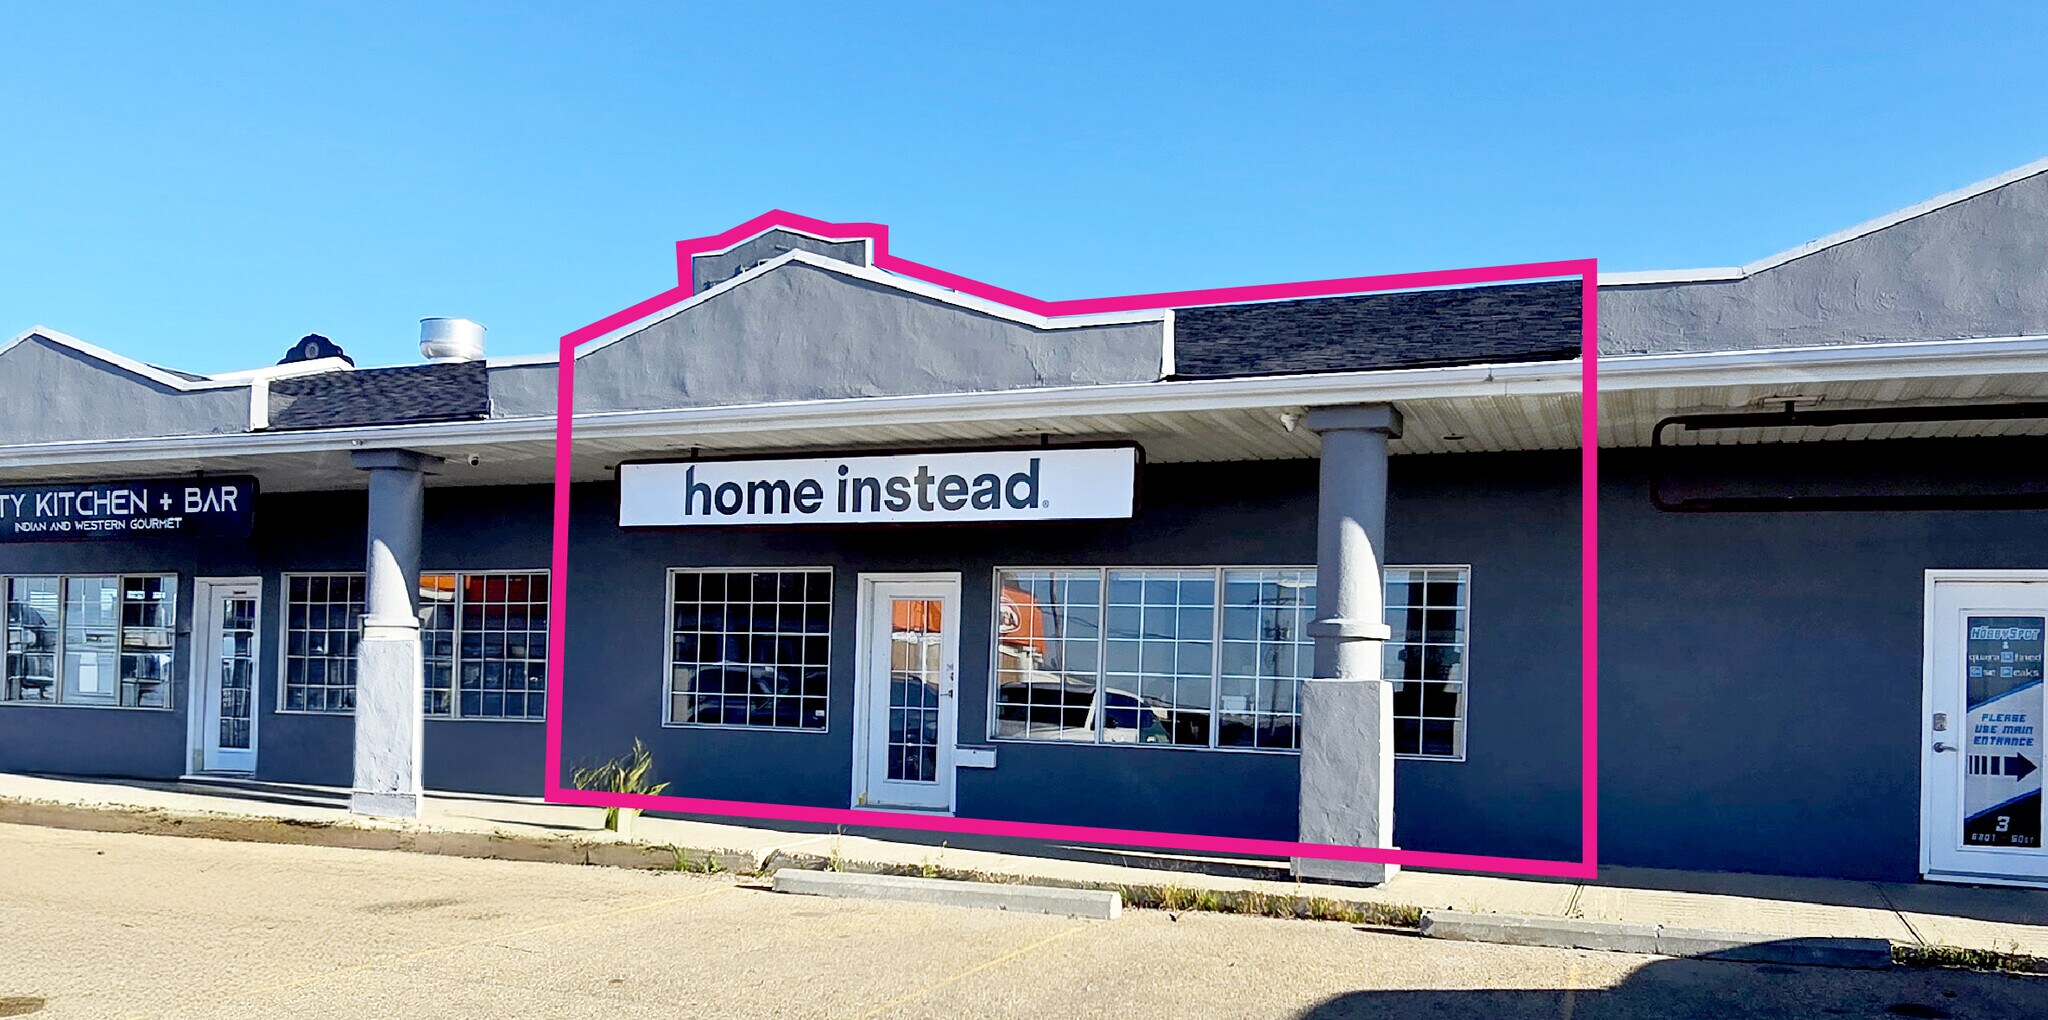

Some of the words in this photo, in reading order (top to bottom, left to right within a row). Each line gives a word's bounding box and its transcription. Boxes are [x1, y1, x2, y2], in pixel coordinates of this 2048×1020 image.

[684, 465, 824, 516] home
[0, 493, 27, 518] TY
[35, 489, 148, 517] KITCHEN
[159, 492, 173, 511] +
[184, 486, 239, 513] BAR
[14, 521, 47, 533] INDIAN
[49, 520, 72, 532] AND
[74, 519, 126, 531] WESTERN
[130, 517, 183, 530] GOURMET
[1981, 713, 2028, 723] PLEASE
[1974, 724, 1999, 734] USE
[2001, 725, 2034, 735] MAIN
[1973, 735, 2035, 747] ENTRANCE
[1995, 815, 2011, 832] 3
